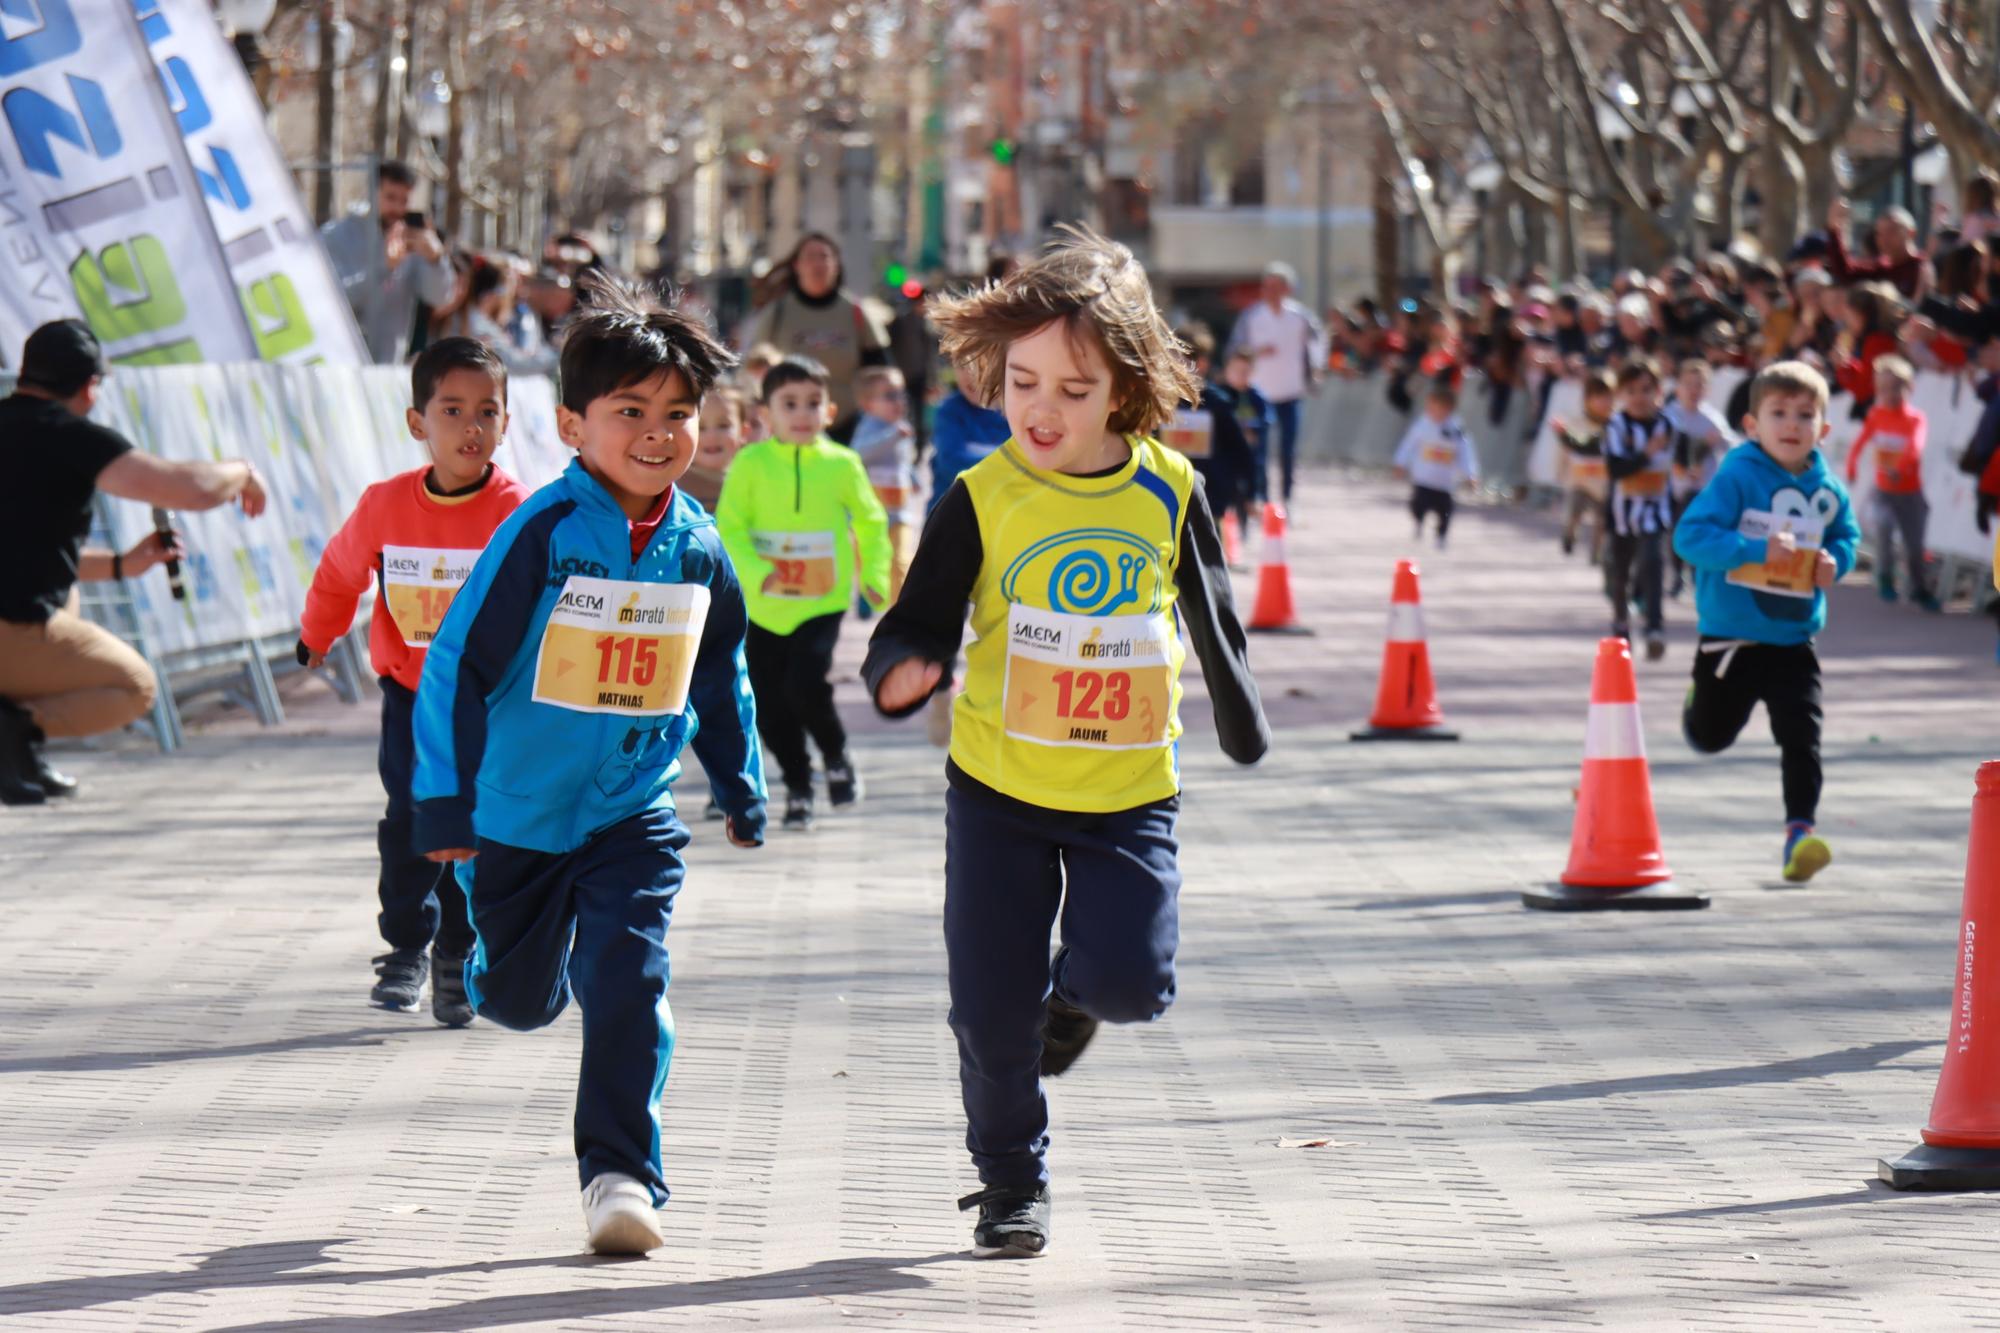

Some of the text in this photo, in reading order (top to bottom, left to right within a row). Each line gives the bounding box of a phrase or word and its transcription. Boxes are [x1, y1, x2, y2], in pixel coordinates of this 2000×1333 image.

[619, 606, 664, 625] marató
[1081, 637, 1130, 659] marató
[595, 636, 659, 687] 115
[597, 692, 644, 708] MATHIAS
[1052, 671, 1131, 721] 123
[1069, 727, 1108, 742] JAUME
